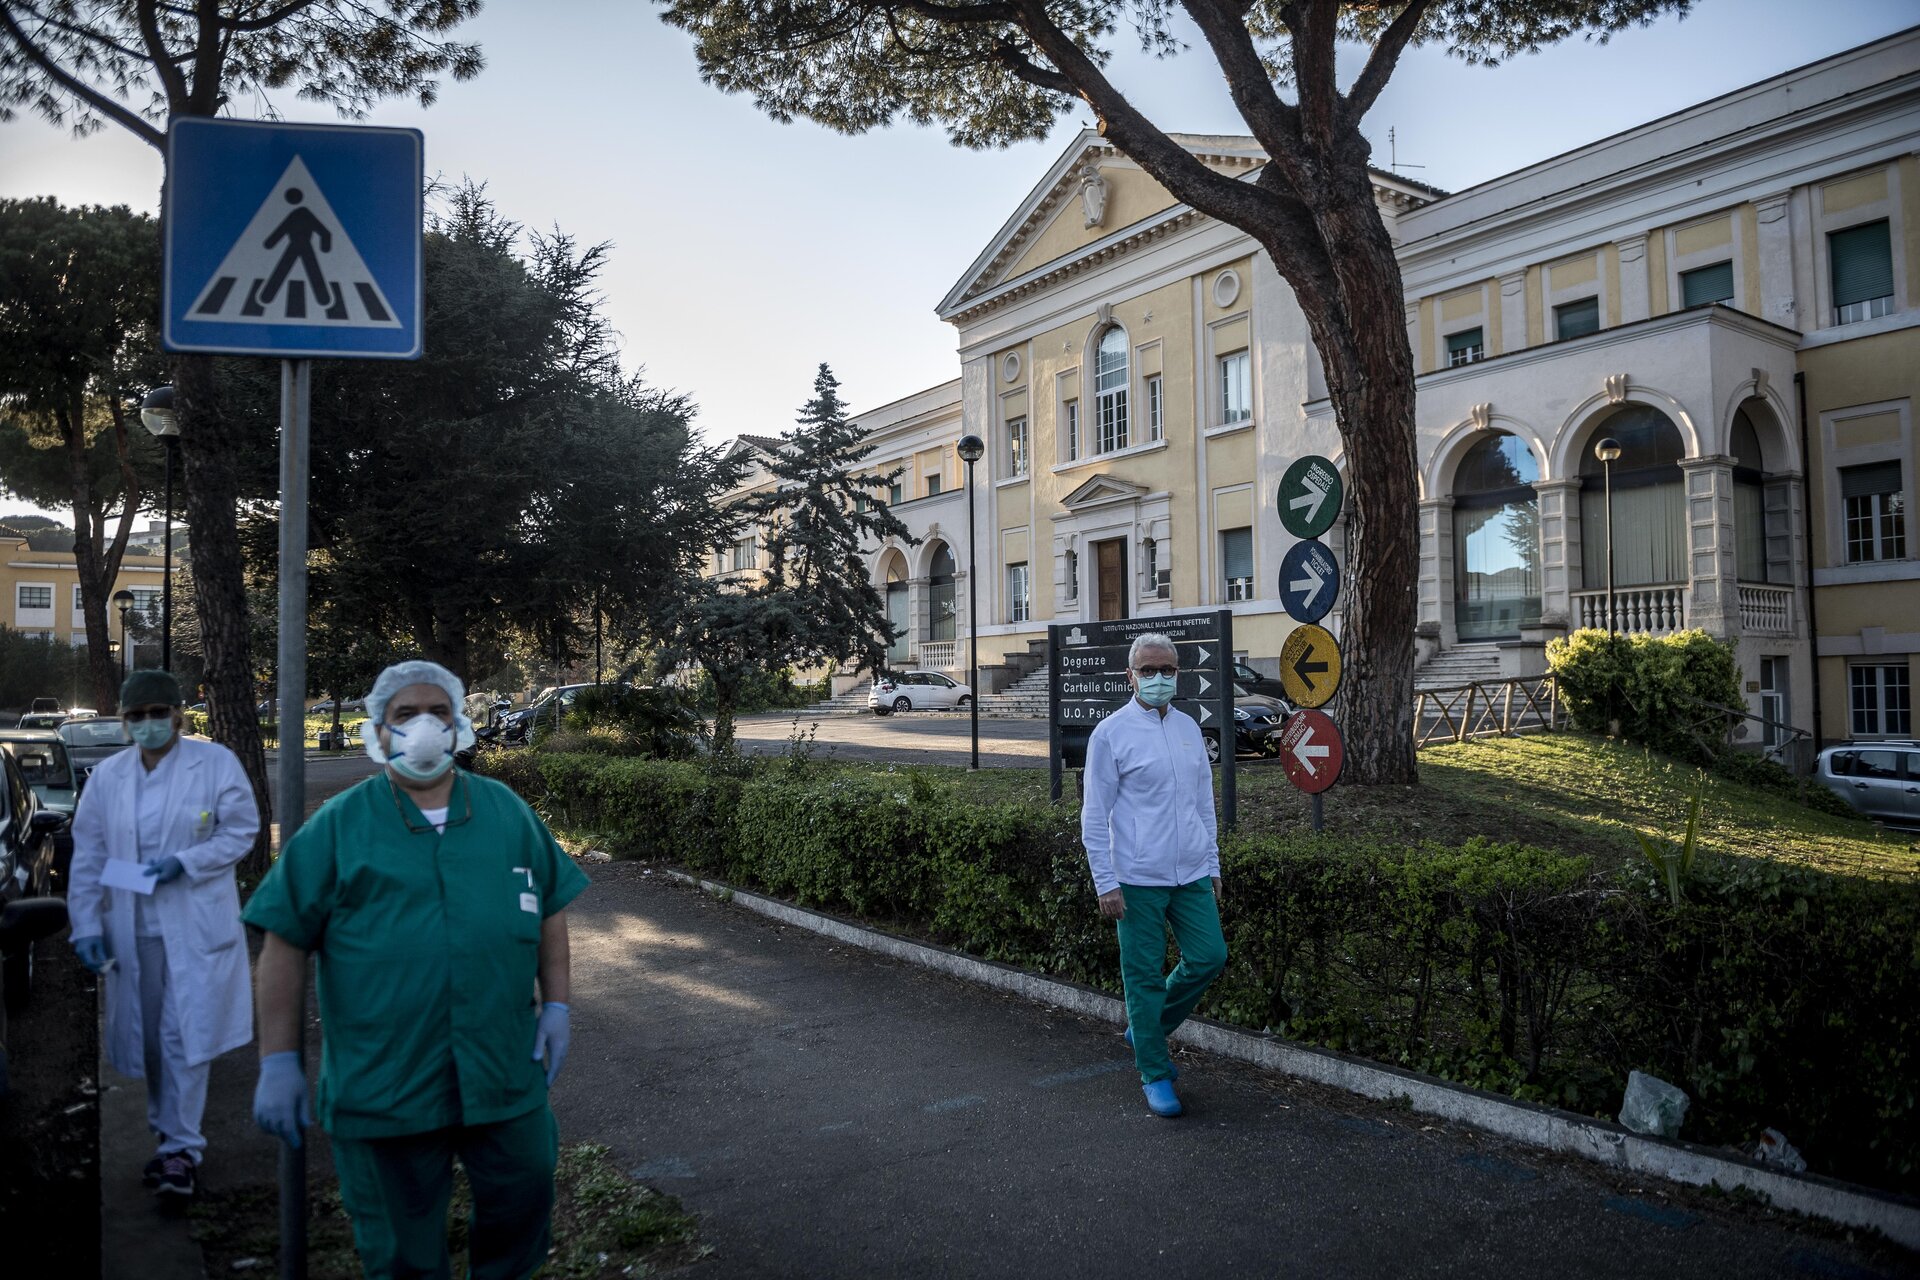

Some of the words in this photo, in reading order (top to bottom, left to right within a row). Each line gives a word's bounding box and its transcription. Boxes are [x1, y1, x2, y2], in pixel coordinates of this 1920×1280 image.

[1306, 470, 1331, 493] OSPEDALE
[1310, 462, 1334, 485] INGRESSO
[1310, 558, 1325, 576] TICKET
[1103, 624, 1124, 632] ISTITUTO
[1125, 622, 1154, 631] NAZIONALE
[1155, 620, 1182, 629] MALATTIE
[1182, 617, 1210, 626] INFETTIVE
[1063, 656, 1106, 668] Degenze
[1063, 682, 1100, 693] Cartelle
[1104, 681, 1133, 692] Clinic
[1063, 708, 1085, 718] U.O.
[1089, 708, 1113, 718] Psic
[1289, 723, 1307, 746] FARMACI
